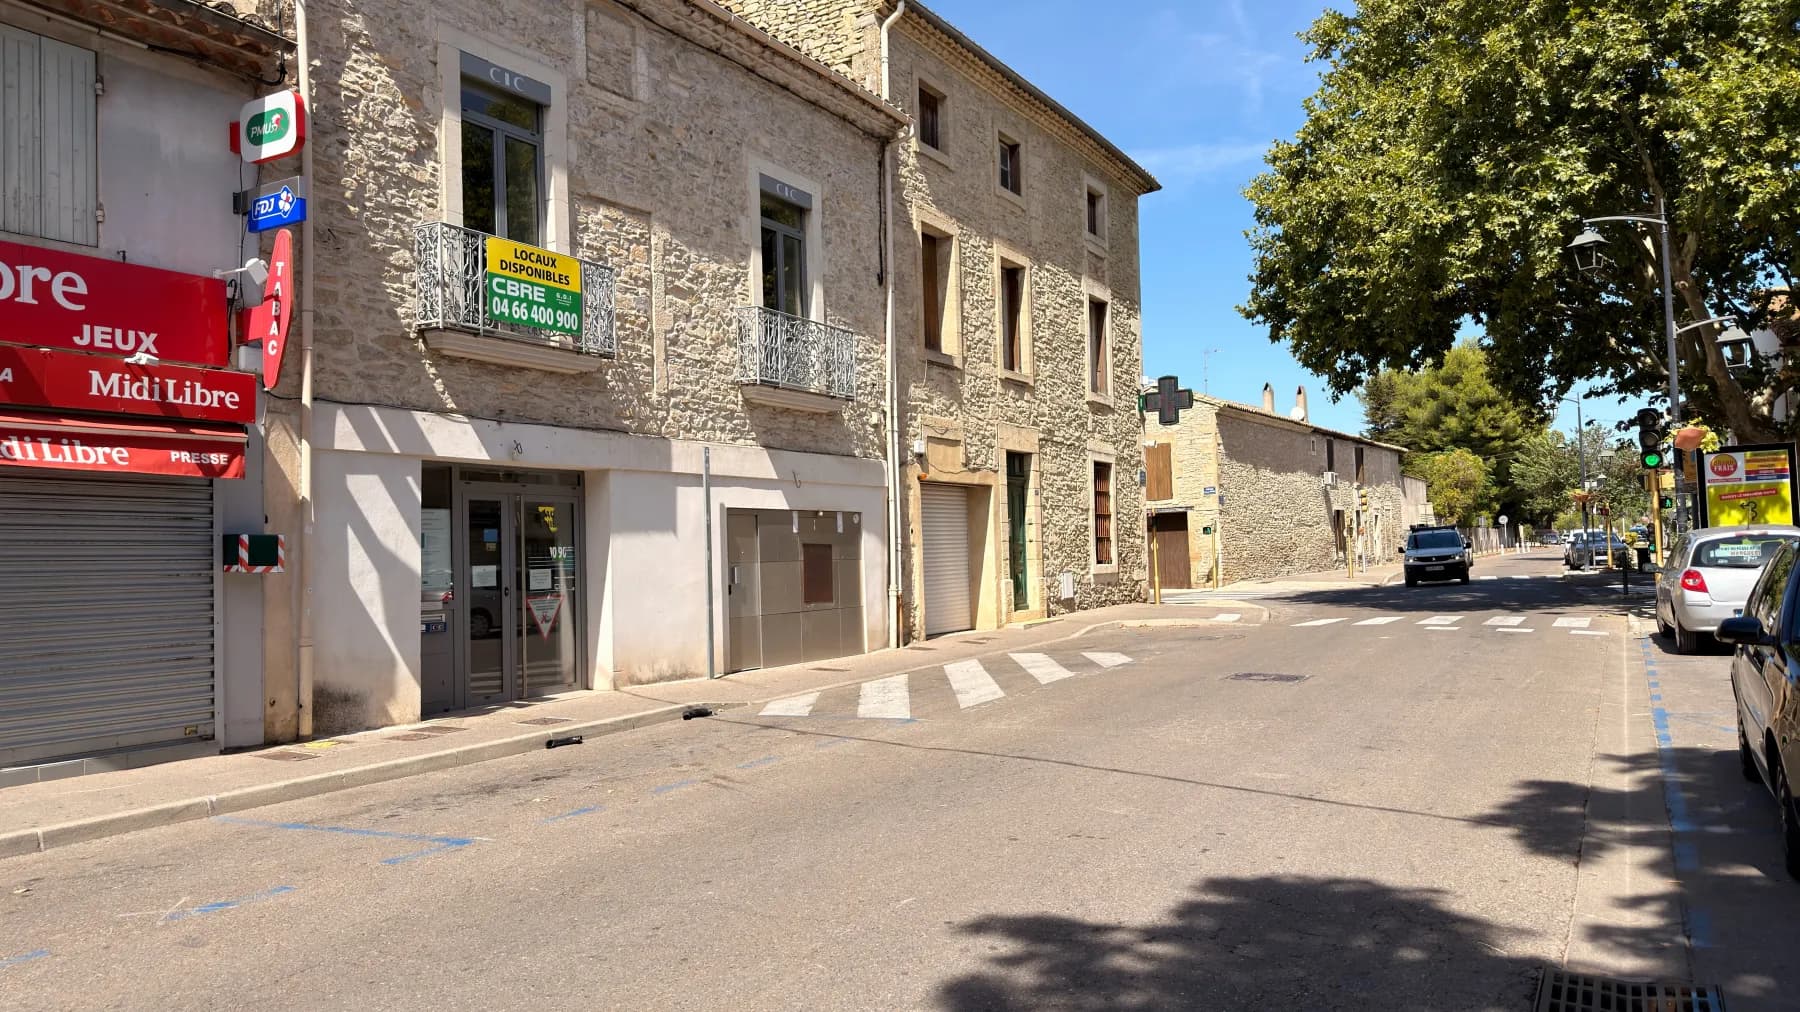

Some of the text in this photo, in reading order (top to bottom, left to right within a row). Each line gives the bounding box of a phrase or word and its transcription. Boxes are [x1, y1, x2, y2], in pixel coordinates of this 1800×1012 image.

[489, 67, 526, 92] CIC
[776, 183, 798, 201] CIC
[254, 198, 274, 217] FDJ
[514, 247, 557, 269] LOCAUX
[500, 259, 570, 286] DISPONIBLES
[492, 277, 546, 303] CBRE
[267, 261, 285, 356] TABAC
[492, 297, 578, 331] 04 66 400 900
[72, 324, 159, 353] JEUX
[89, 370, 240, 410] Midi Libre
[38, 437, 129, 465] Libre
[170, 450, 229, 466] PRESSE
